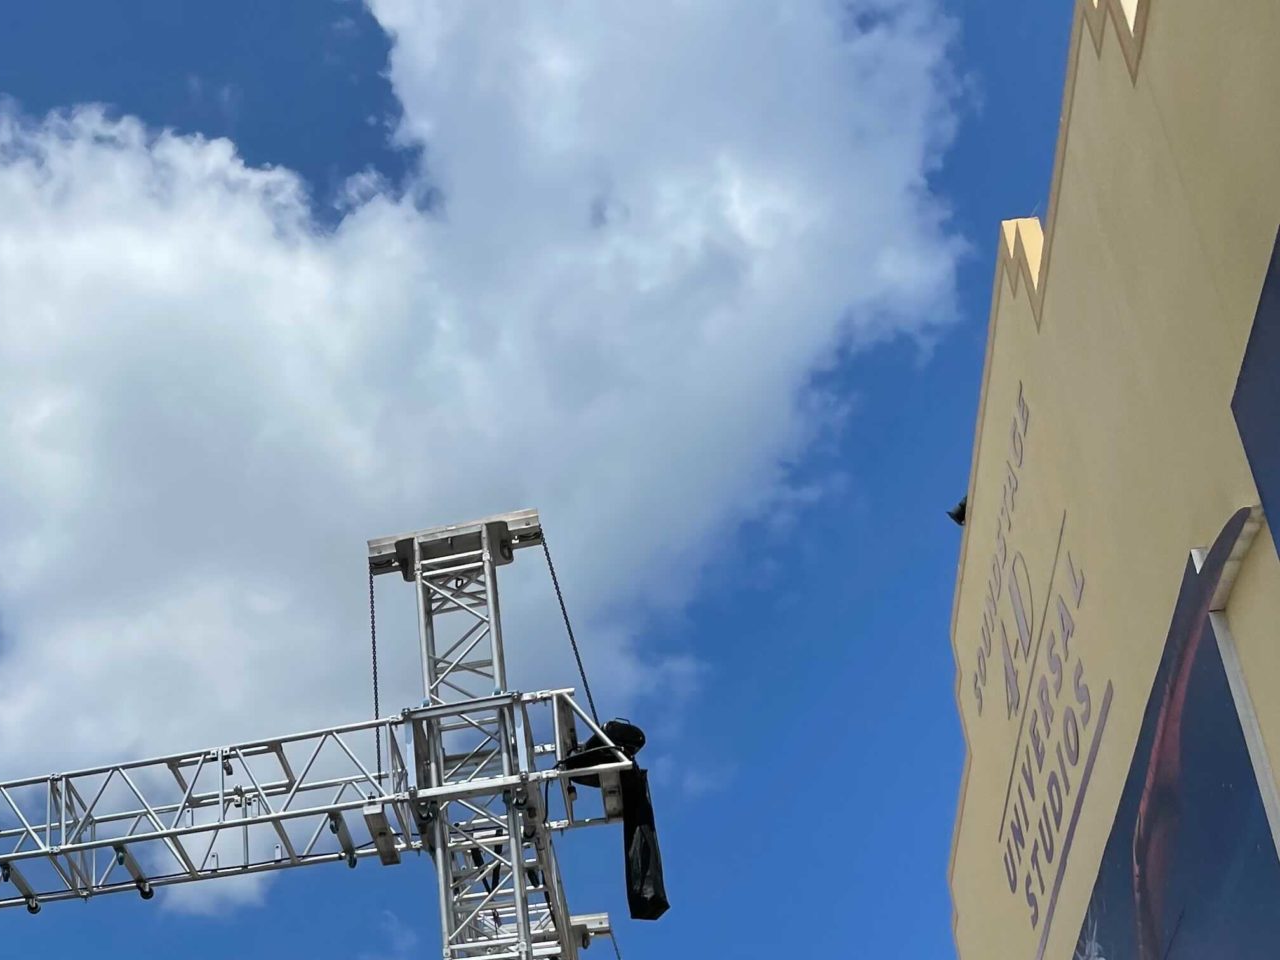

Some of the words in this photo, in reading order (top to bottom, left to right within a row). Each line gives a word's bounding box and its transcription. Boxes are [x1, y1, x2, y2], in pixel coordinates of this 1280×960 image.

[973, 379, 1031, 718] SOUNDSTAGE
[1000, 551, 1035, 721] 4-D
[1003, 550, 1085, 895] UNIVERSAL
[1023, 656, 1092, 931] STUDIOS
